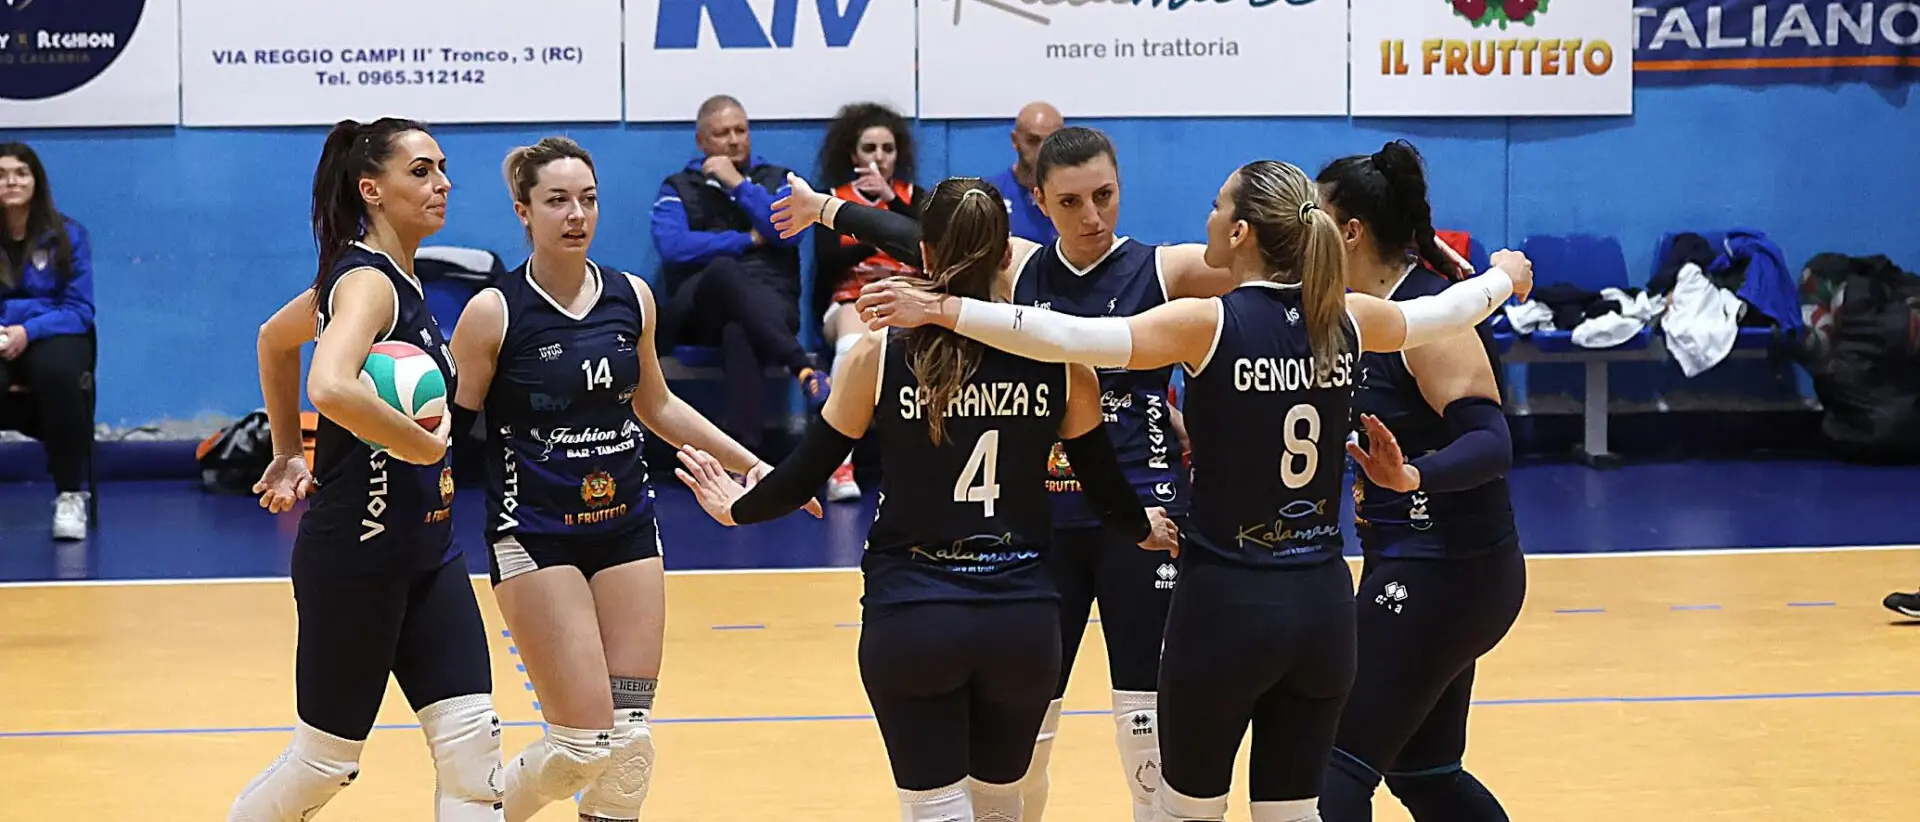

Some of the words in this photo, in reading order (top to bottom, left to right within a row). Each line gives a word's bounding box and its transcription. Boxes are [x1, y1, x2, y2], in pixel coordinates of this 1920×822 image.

[212, 50, 247, 64] VIA
[254, 49, 333, 64] REGGIO
[341, 48, 405, 63] CAMPI
[441, 48, 517, 64] Tronco,
[524, 47, 535, 61] 3
[542, 47, 583, 64] (RC)
[1046, 42, 1107, 58] mare
[1114, 39, 1135, 57] in
[1142, 37, 1239, 56] trattoria
[1380, 40, 1408, 75] IL
[1422, 38, 1613, 76] FRUTTETO
[316, 71, 350, 86] Tel.
[358, 69, 485, 85] 0965.312142
[581, 357, 613, 391] 14
[549, 428, 617, 444] Fashion
[1281, 403, 1321, 489] 8
[954, 429, 1000, 518] 4
[497, 447, 519, 532] VOLLEY
[564, 514, 574, 525] IL
[577, 503, 627, 524] FRUTTETO
